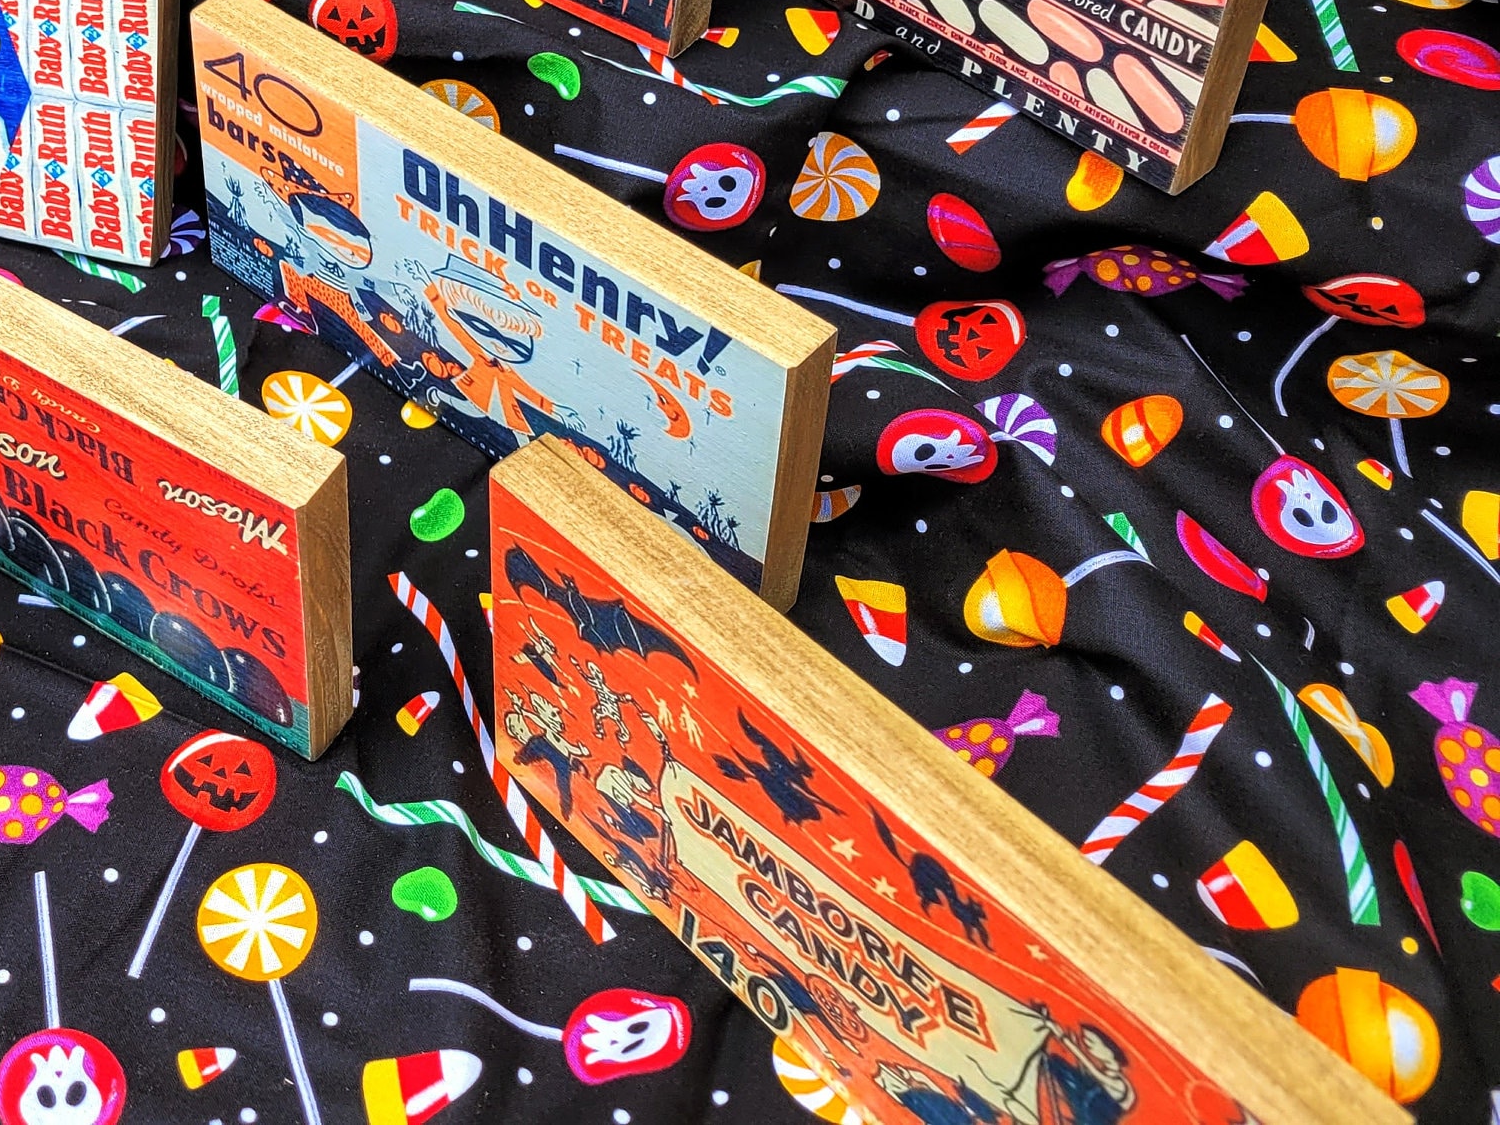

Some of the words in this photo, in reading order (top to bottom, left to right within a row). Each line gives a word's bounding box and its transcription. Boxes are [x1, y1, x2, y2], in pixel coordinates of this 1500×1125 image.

[34, 32, 64, 89] Baby
[78, 38, 109, 98] Baby
[122, 45, 156, 104] Baby
[1119, 8, 1204, 66] CANDY
[200, 80, 263, 127] wrapped
[268, 122, 345, 178] miniature
[203, 52, 323, 138] 40
[206, 94, 277, 164] bars
[895, 25, 941, 55] and
[960, 56, 1149, 174] PLENTY
[36, 104, 68, 165] Ruth
[80, 111, 115, 174] Ruth
[40, 172, 74, 242] Baby
[88, 182, 124, 254] Baby
[395, 193, 507, 277] TRICK
[525, 279, 559, 310] OR
[574, 305, 736, 420] TREATS
[34, 411, 137, 487] Black
[103, 497, 184, 557] Candy
[193, 545, 284, 610] Drops
[158, 479, 289, 556] Mason
[3, 459, 134, 573] Black
[136, 548, 288, 660] Crows
[680, 791, 990, 1043] JAMBOREE
[678, 904, 792, 1034] 140
[741, 877, 934, 1039] CANDY
